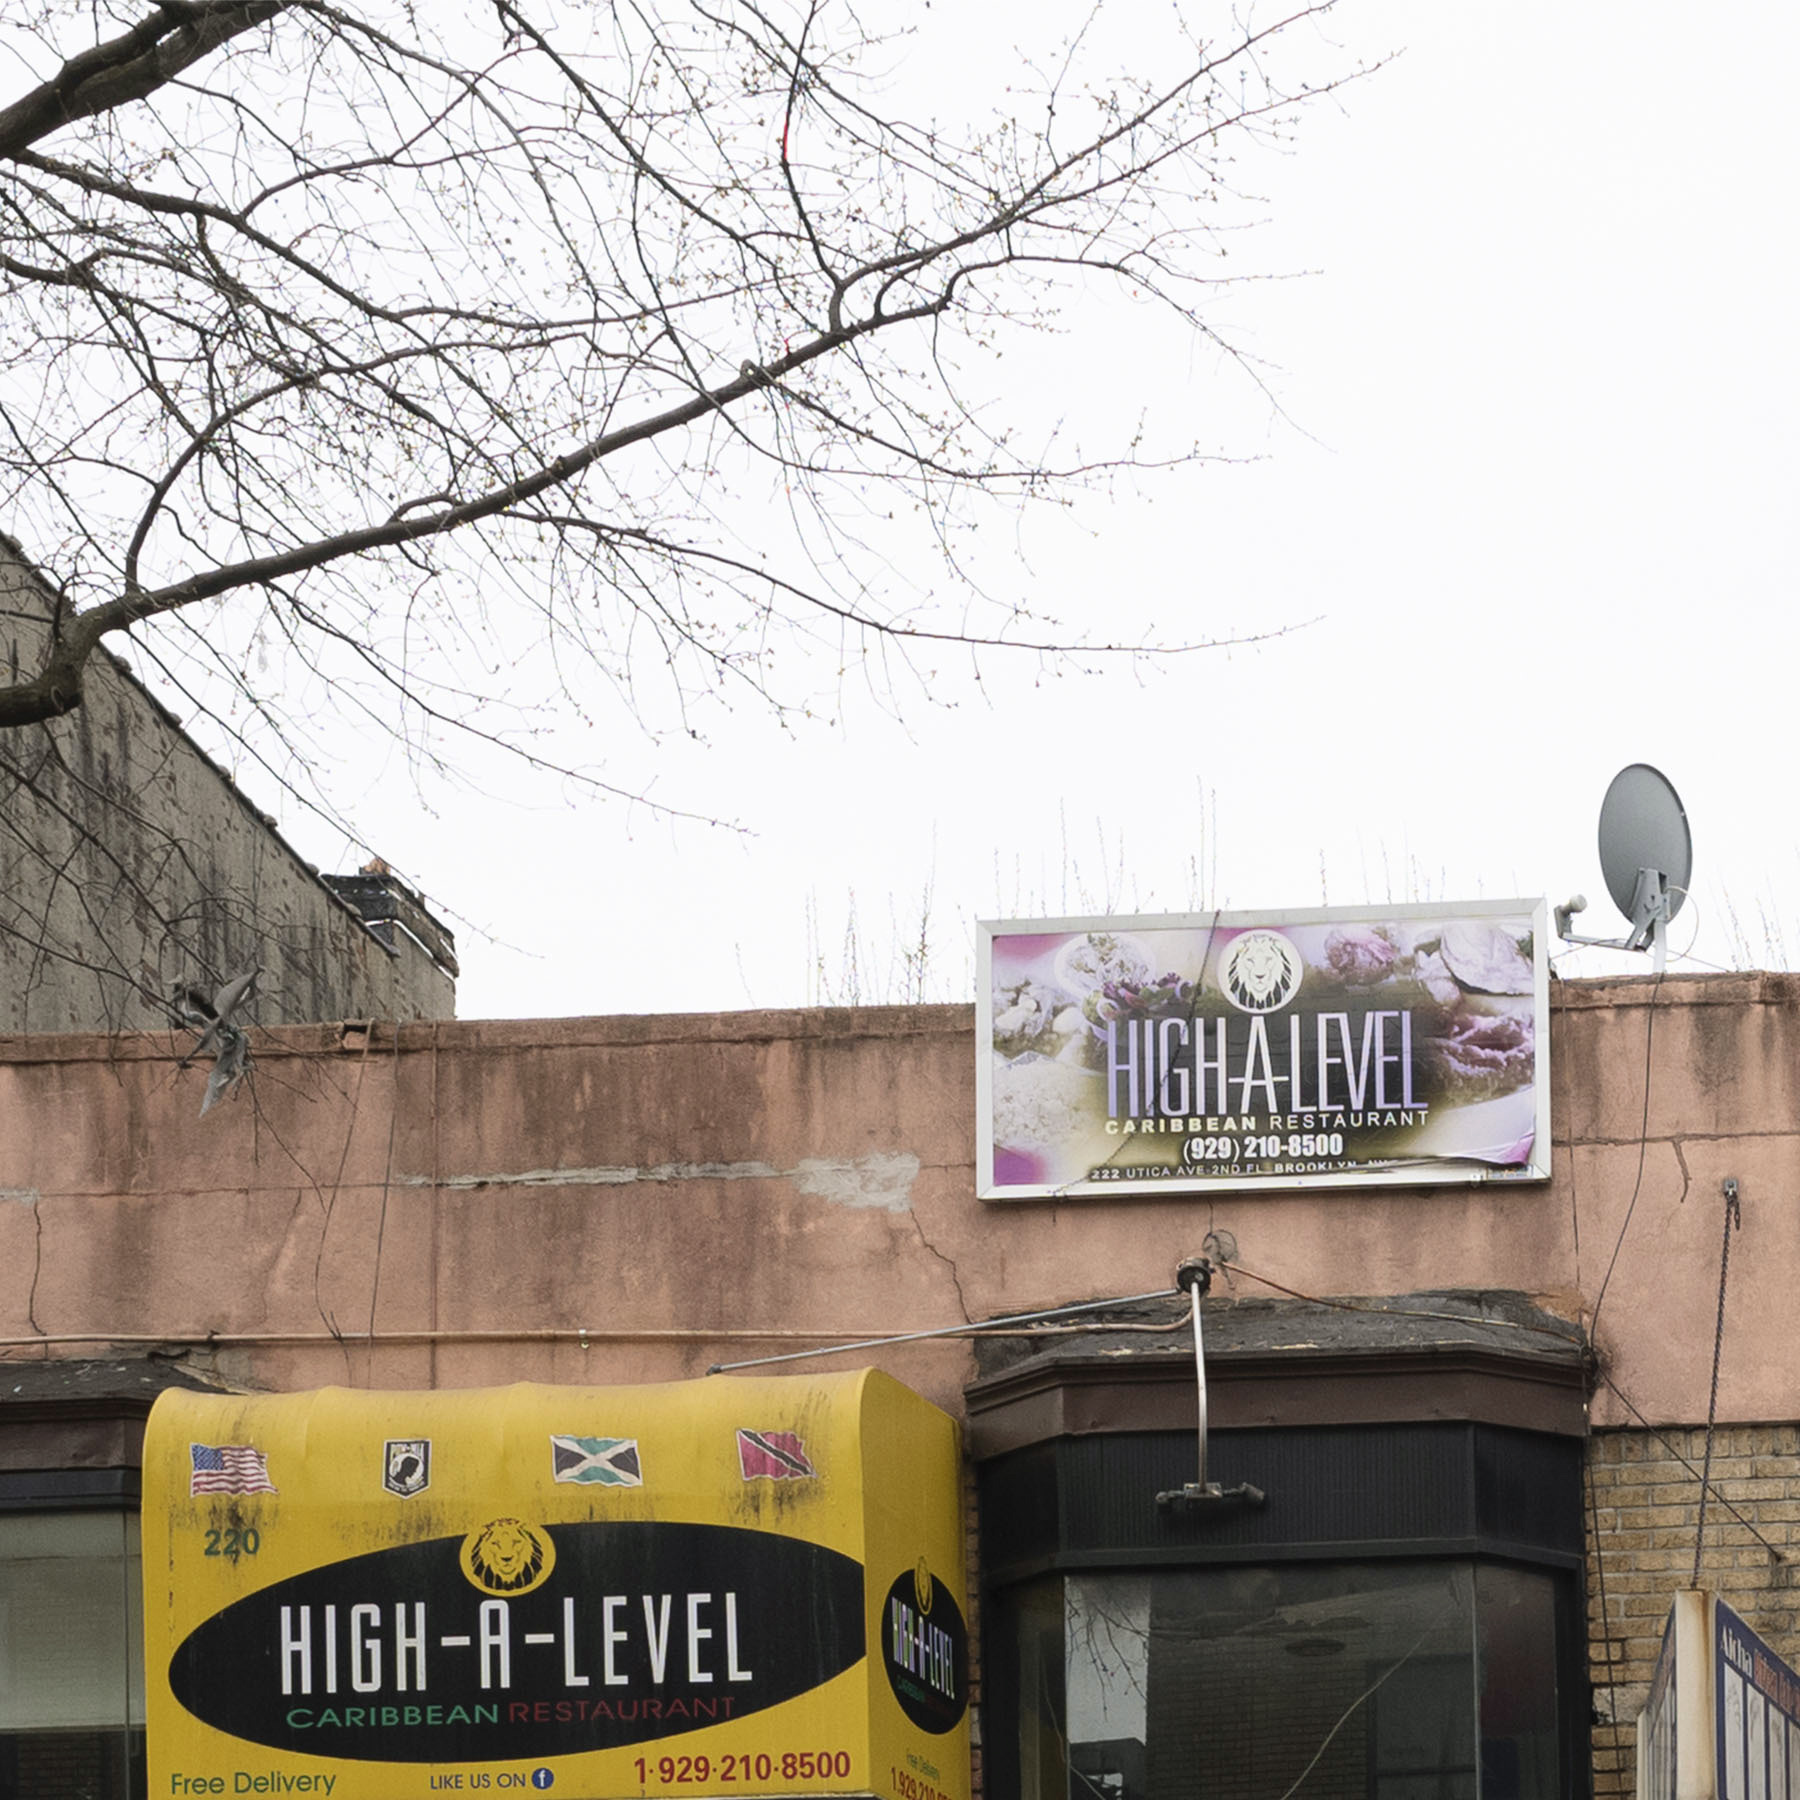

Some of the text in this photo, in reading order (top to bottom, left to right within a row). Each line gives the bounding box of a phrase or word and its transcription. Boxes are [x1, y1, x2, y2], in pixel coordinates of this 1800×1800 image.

[1105, 1110, 1429, 1135] CARIBBEAN RESTAURANT
[1183, 1133, 1343, 1163] (929) 210-8500
[1091, 1169, 1120, 1180] 222
[1127, 1166, 1170, 1178] UTICA
[204, 1528, 261, 1556] 220
[280, 1592, 754, 1696] HIGH-A-LEVEL
[285, 1696, 736, 1730] CARIBBEAN RESTAURANT
[170, 1767, 336, 1800] Free Delivery
[430, 1772, 526, 1790] LIKE US ON
